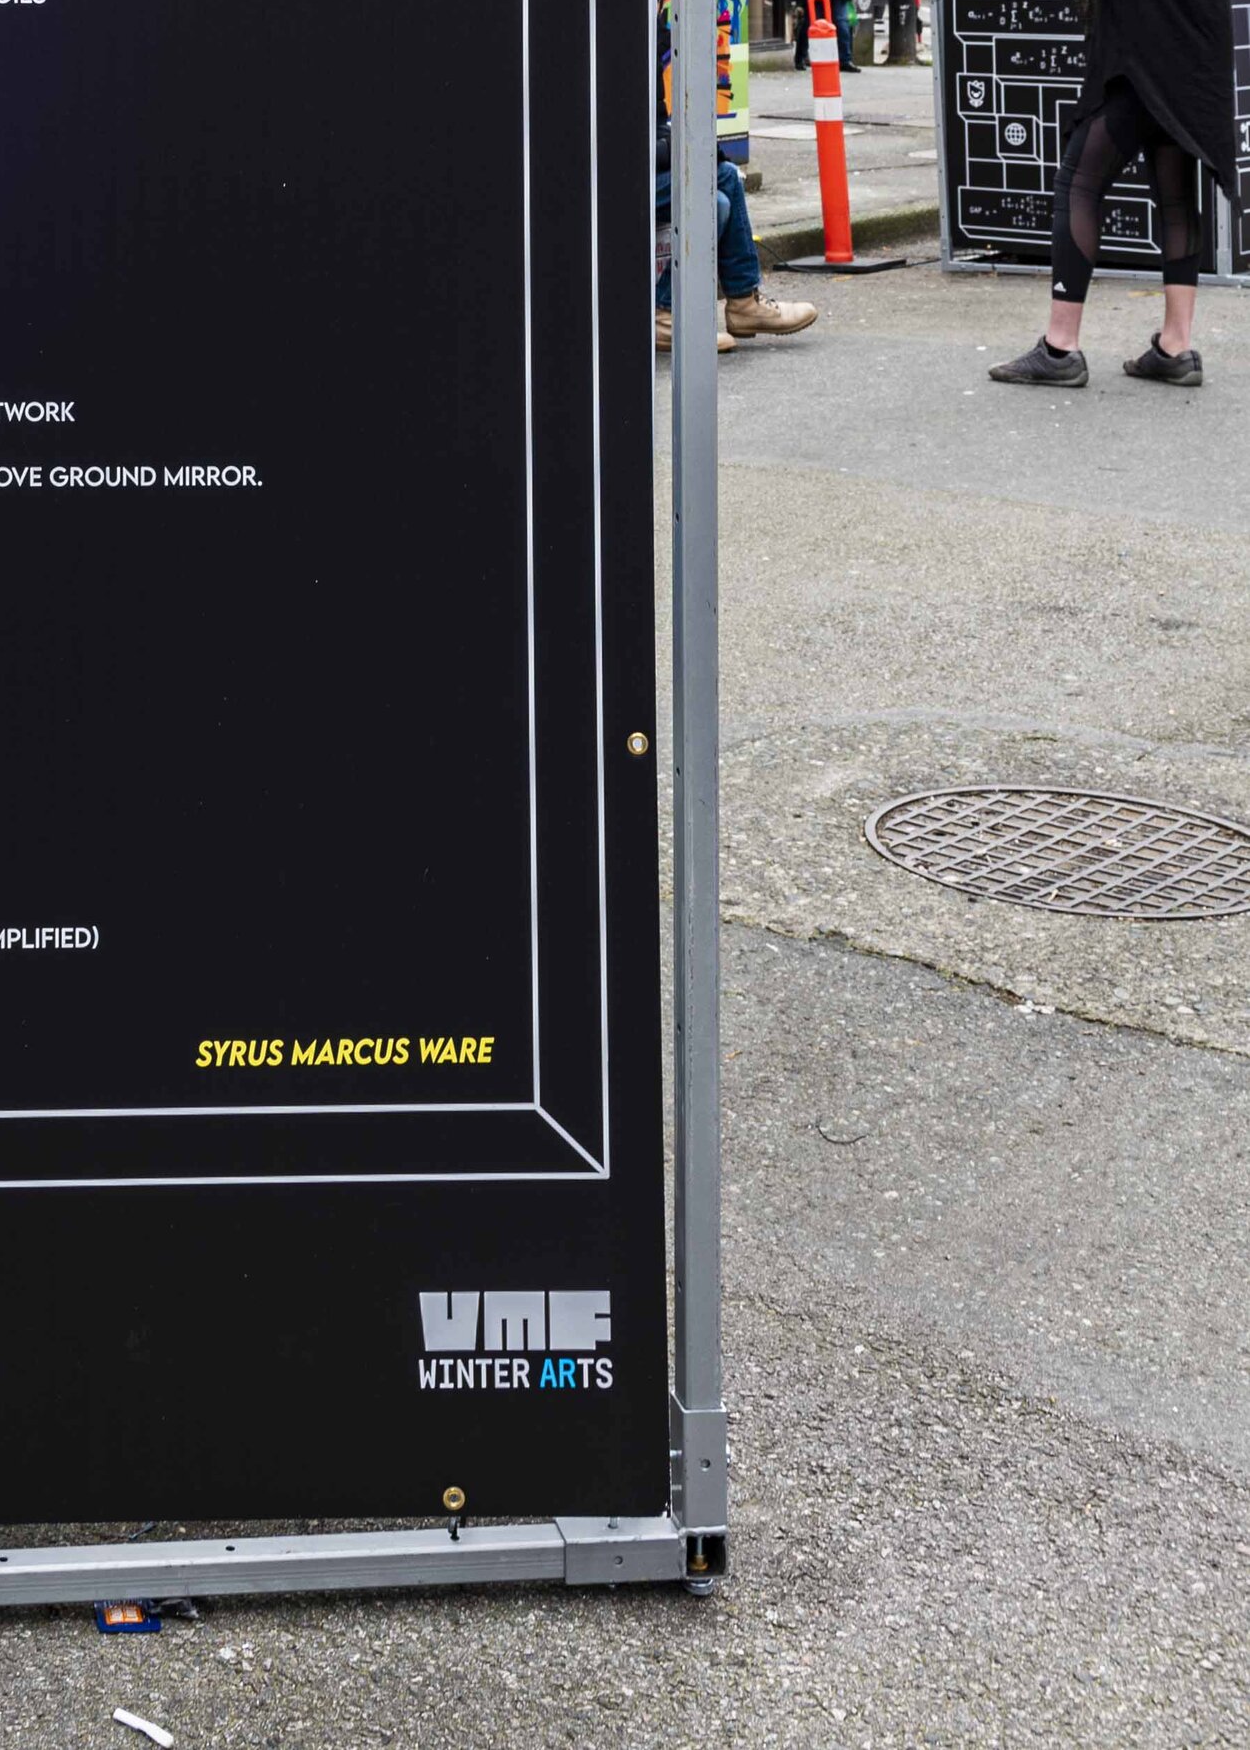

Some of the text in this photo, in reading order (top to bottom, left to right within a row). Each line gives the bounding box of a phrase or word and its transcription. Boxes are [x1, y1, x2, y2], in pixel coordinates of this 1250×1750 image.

[196, 1037, 494, 1067] SYRUS MARCUS WARE
[419, 1357, 613, 1389] WINTER ARTS
